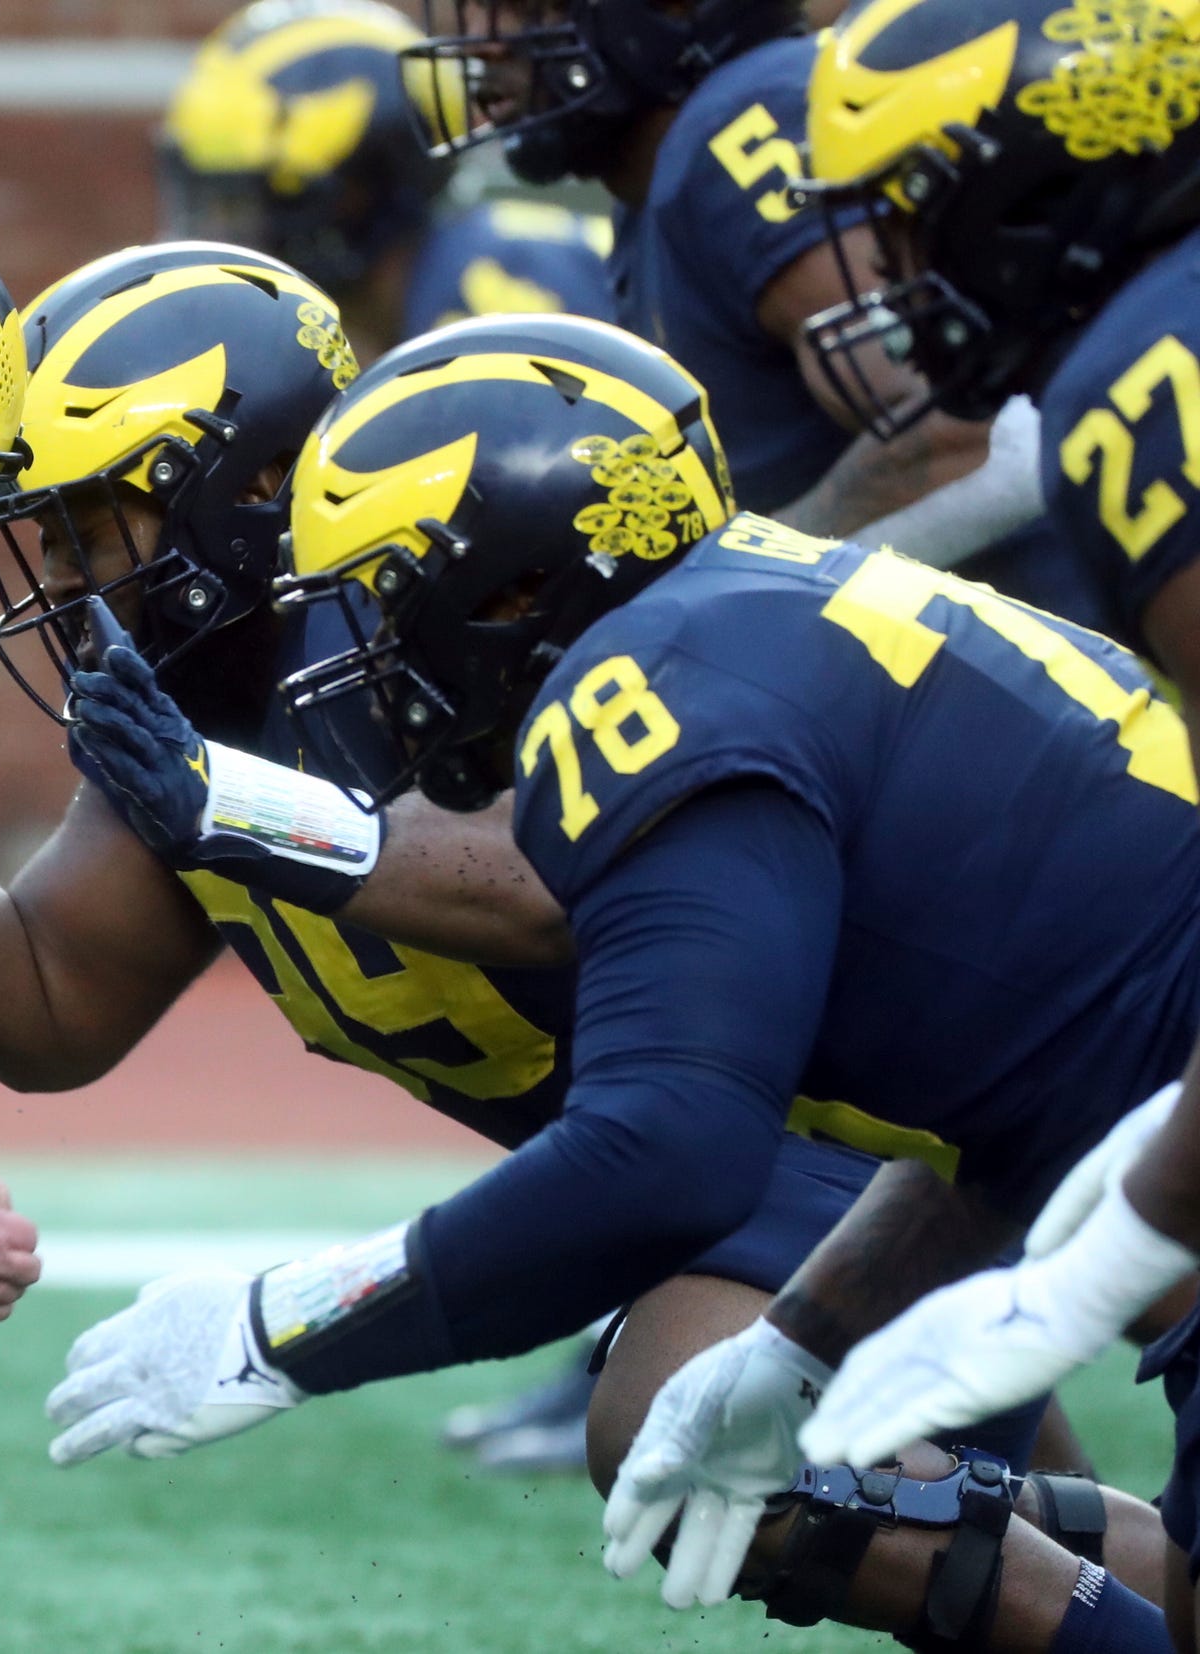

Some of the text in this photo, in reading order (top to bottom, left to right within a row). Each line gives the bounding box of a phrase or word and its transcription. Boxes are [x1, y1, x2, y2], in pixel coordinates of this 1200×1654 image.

[708, 102, 802, 224] 5
[676, 510, 704, 544] 78
[1059, 333, 1200, 563] 27
[519, 654, 681, 843] 78
[821, 545, 1200, 808] 7
